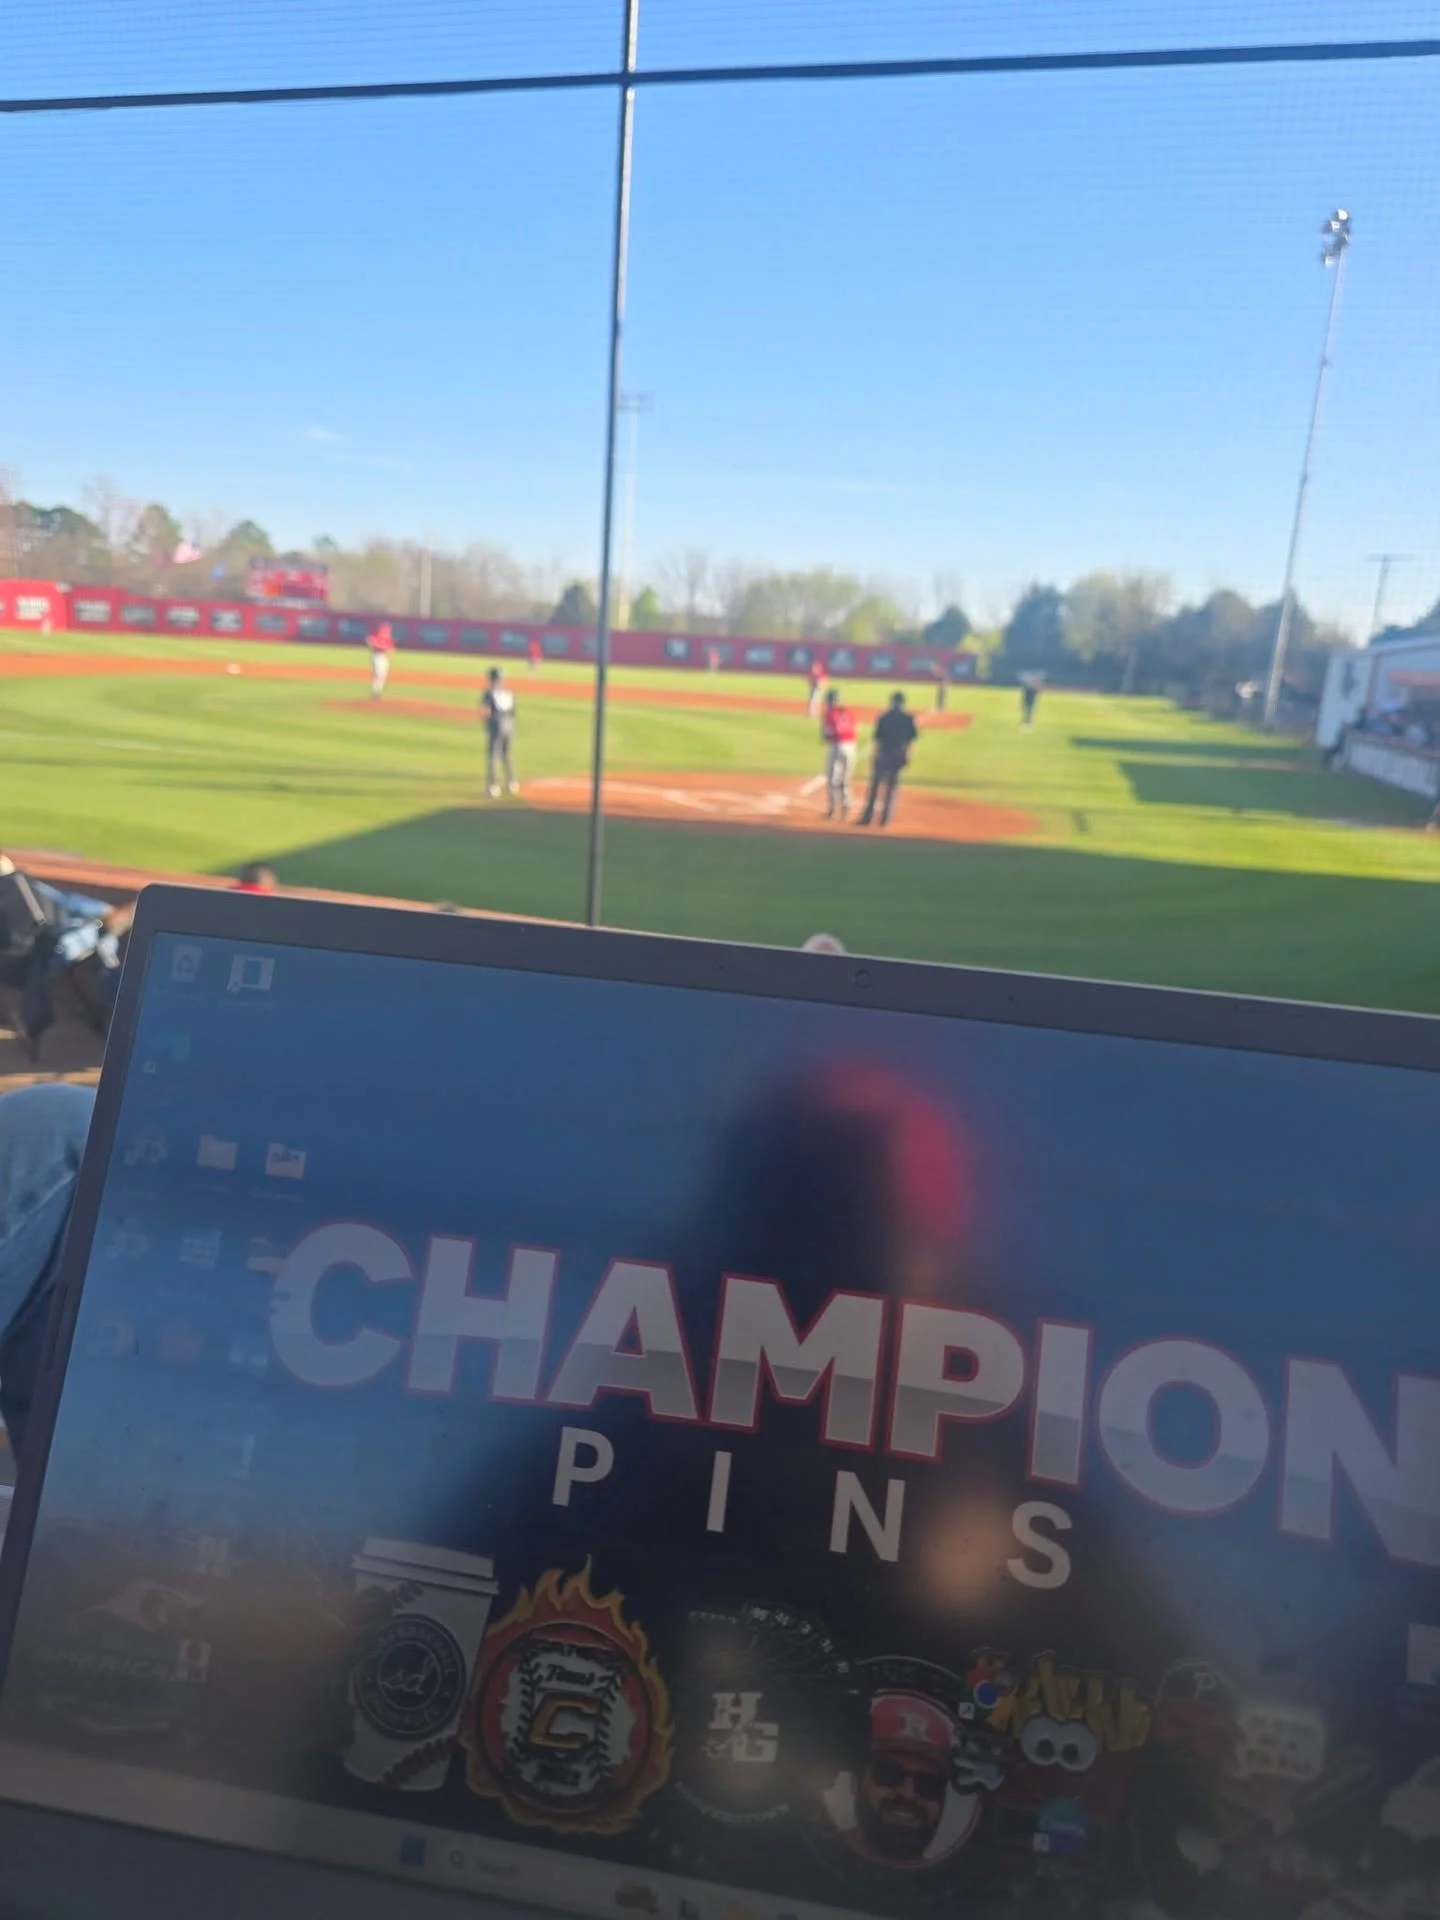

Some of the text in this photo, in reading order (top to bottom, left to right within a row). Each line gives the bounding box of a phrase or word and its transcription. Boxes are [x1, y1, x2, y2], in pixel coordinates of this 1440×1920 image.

[268, 1221, 1440, 1570] CHAMPION
[552, 1427, 1075, 1590] PINS
[529, 1697, 601, 1751] C
